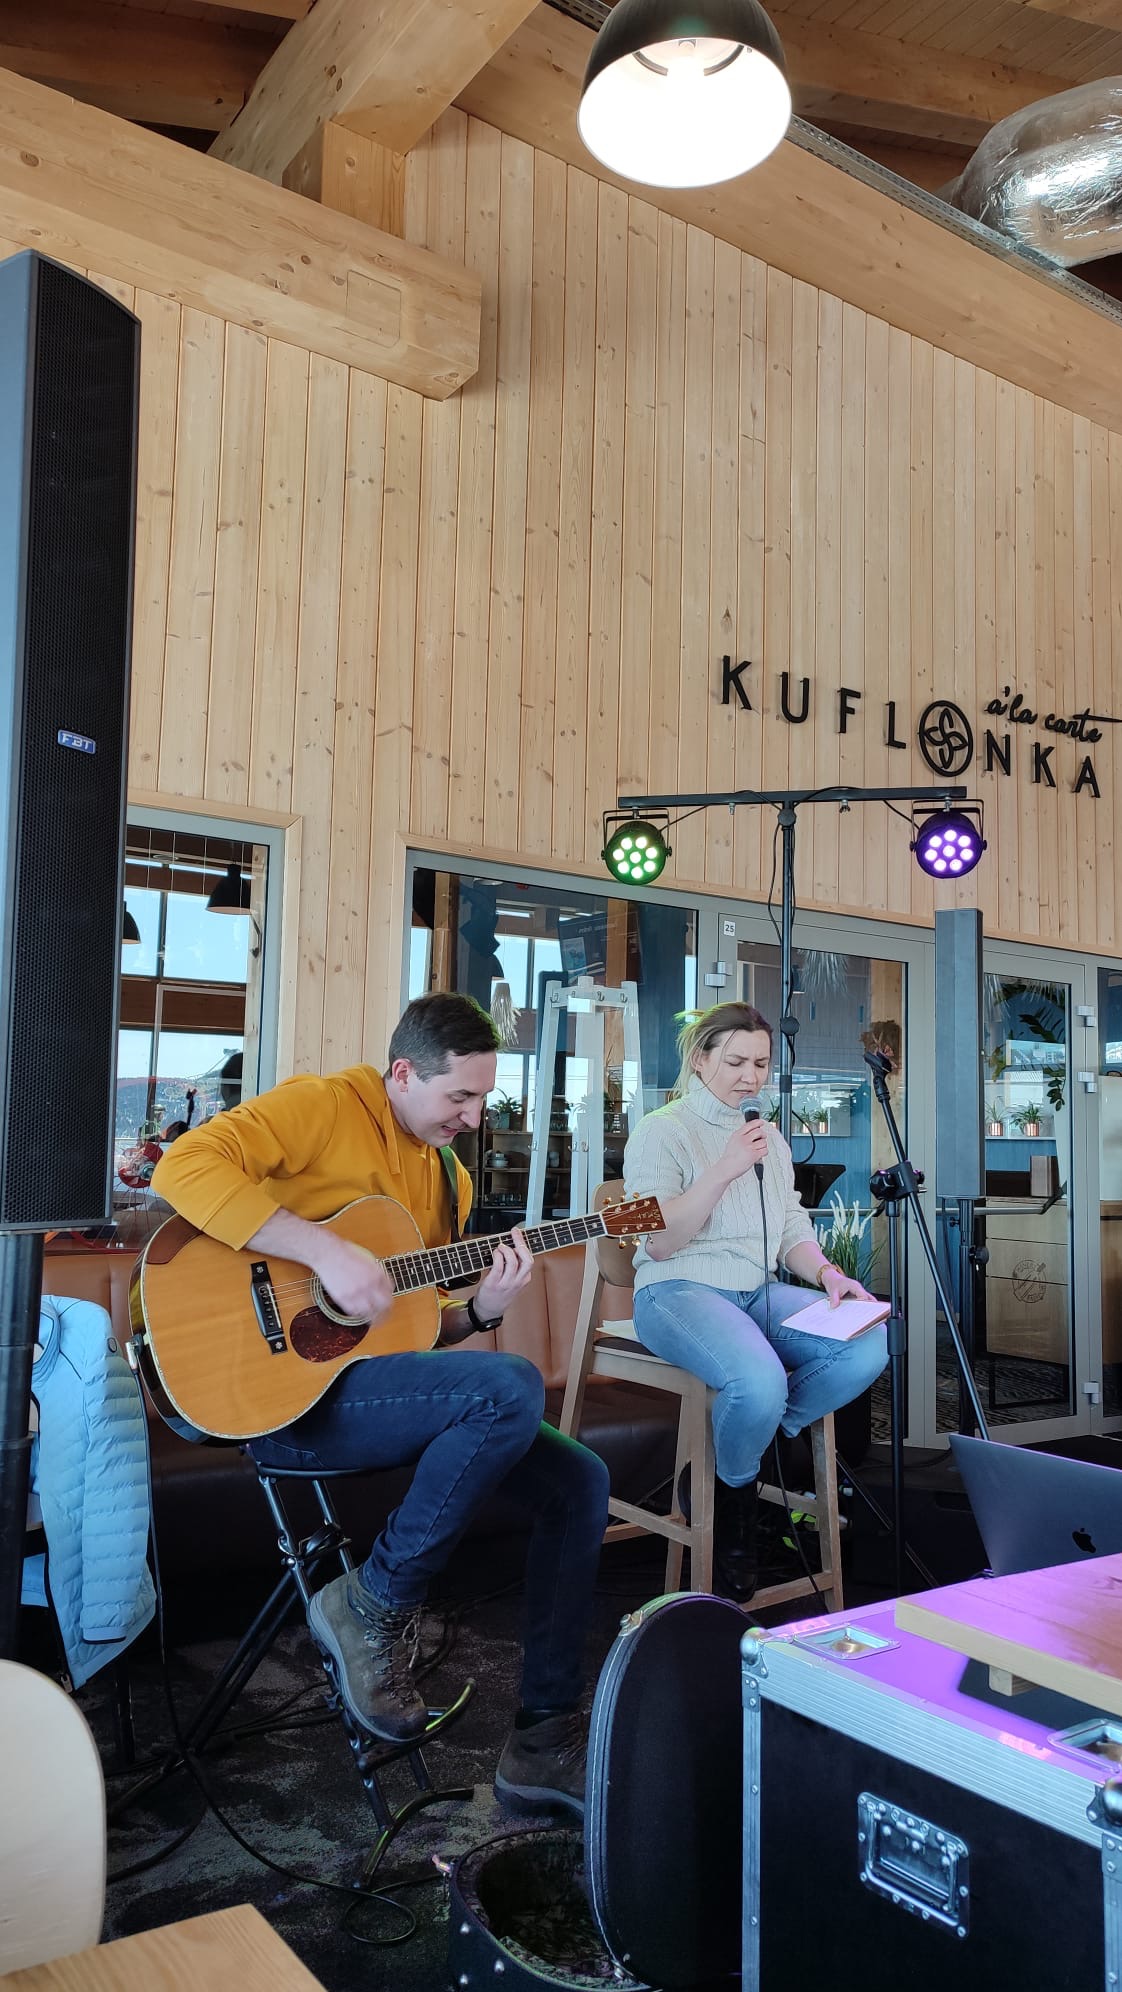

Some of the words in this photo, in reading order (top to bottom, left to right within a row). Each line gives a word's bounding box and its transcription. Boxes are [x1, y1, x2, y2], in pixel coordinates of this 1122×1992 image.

[721, 655, 1100, 798] KUFLONKA
[1045, 708, 1122, 743] carte
[62, 733, 92, 750] FBT
[725, 924, 735, 933] 25
